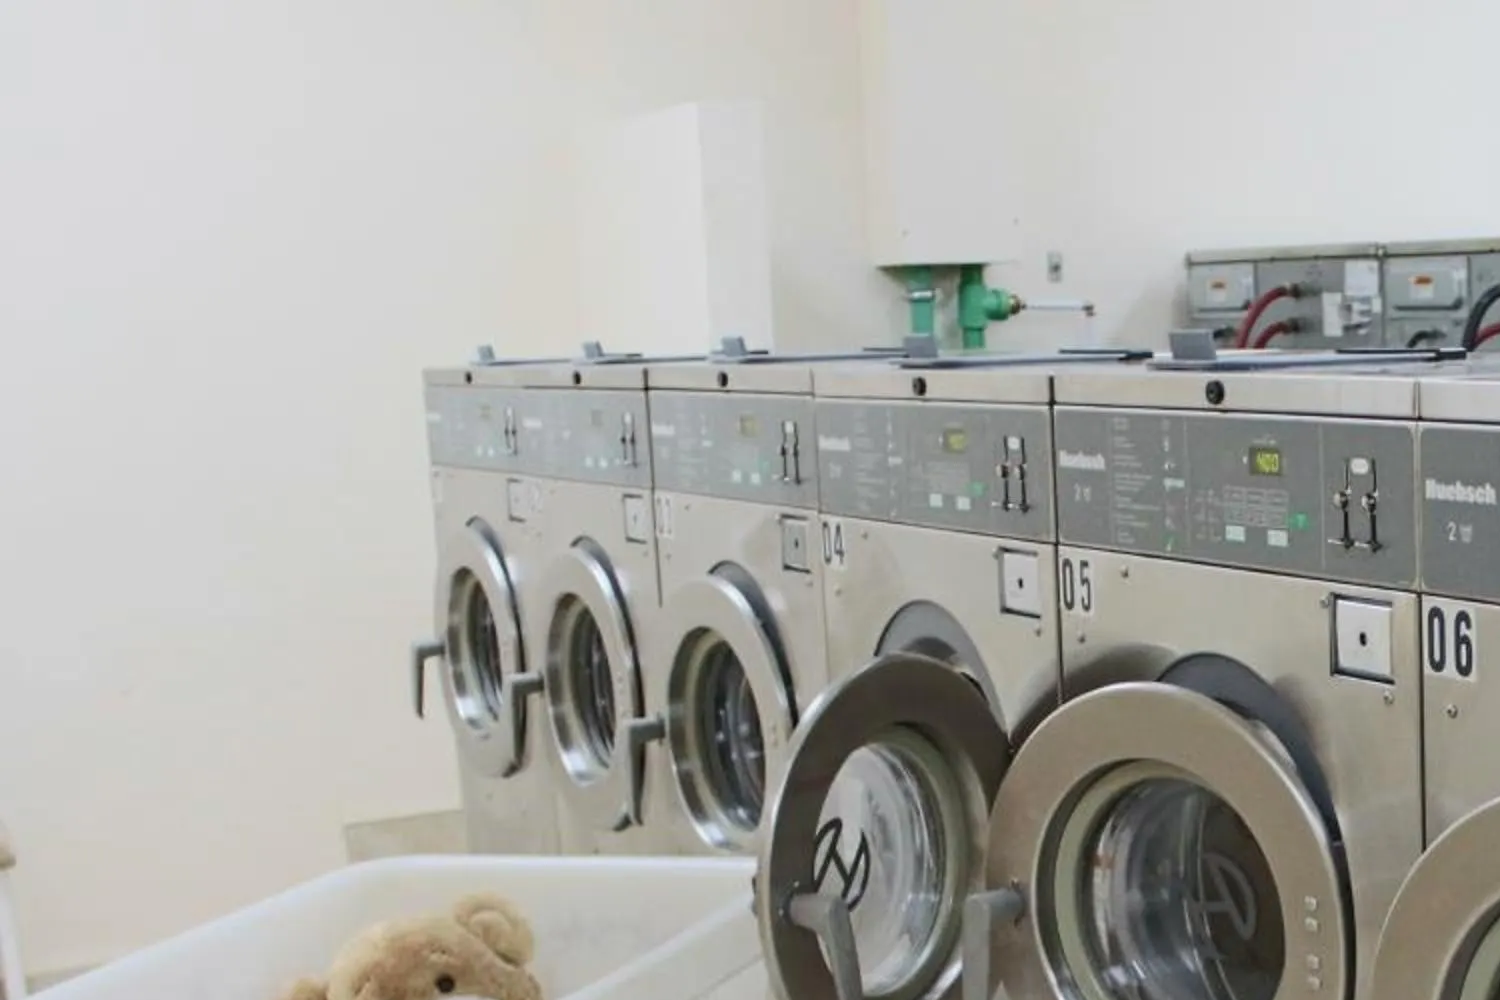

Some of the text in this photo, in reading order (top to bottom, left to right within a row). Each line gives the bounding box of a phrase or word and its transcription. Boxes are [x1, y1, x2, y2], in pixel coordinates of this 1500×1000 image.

[821, 520, 846, 566] 04
[1060, 557, 1092, 613] 05
[1427, 606, 1474, 678] 06
